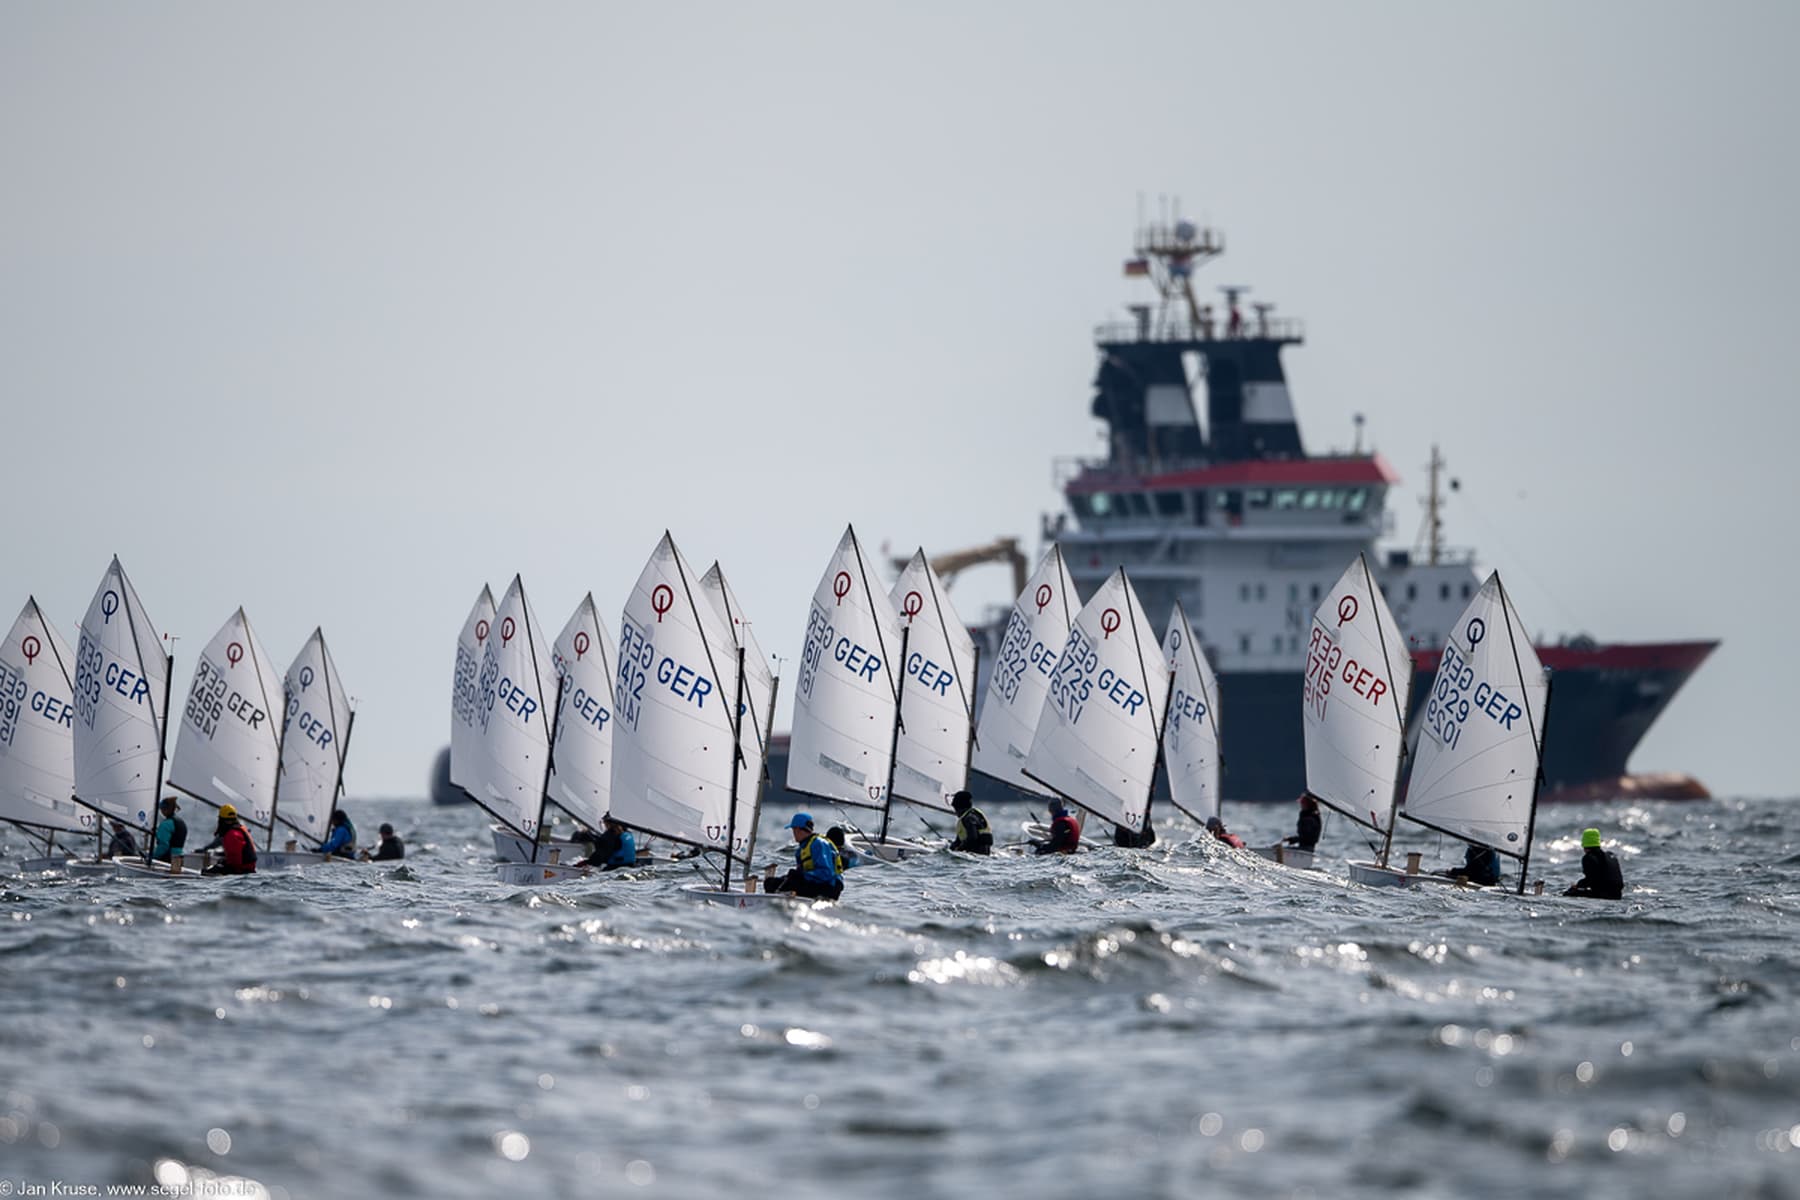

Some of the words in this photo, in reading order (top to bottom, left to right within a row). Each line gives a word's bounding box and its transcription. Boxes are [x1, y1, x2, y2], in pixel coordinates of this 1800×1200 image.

[803, 633, 822, 672] 1611
[835, 636, 882, 683] GER
[907, 652, 953, 696] GER
[1000, 635, 1027, 682] 1322
[1058, 649, 1094, 701] 1725
[1306, 651, 1333, 695] 1715
[106, 662, 149, 705] GER
[617, 651, 646, 701] 1412
[657, 657, 713, 708] GER
[1098, 668, 1145, 716] GER
[1342, 659, 1387, 706] GER
[1433, 671, 1470, 723] 1029
[31, 690, 73, 728] GER
[191, 679, 223, 722] 1466
[227, 691, 265, 730] GER
[498, 677, 537, 723] GER
[573, 688, 611, 731] GER
[1176, 689, 1207, 725] GER
[1474, 682, 1522, 731] GER
[299, 711, 333, 750] GER
